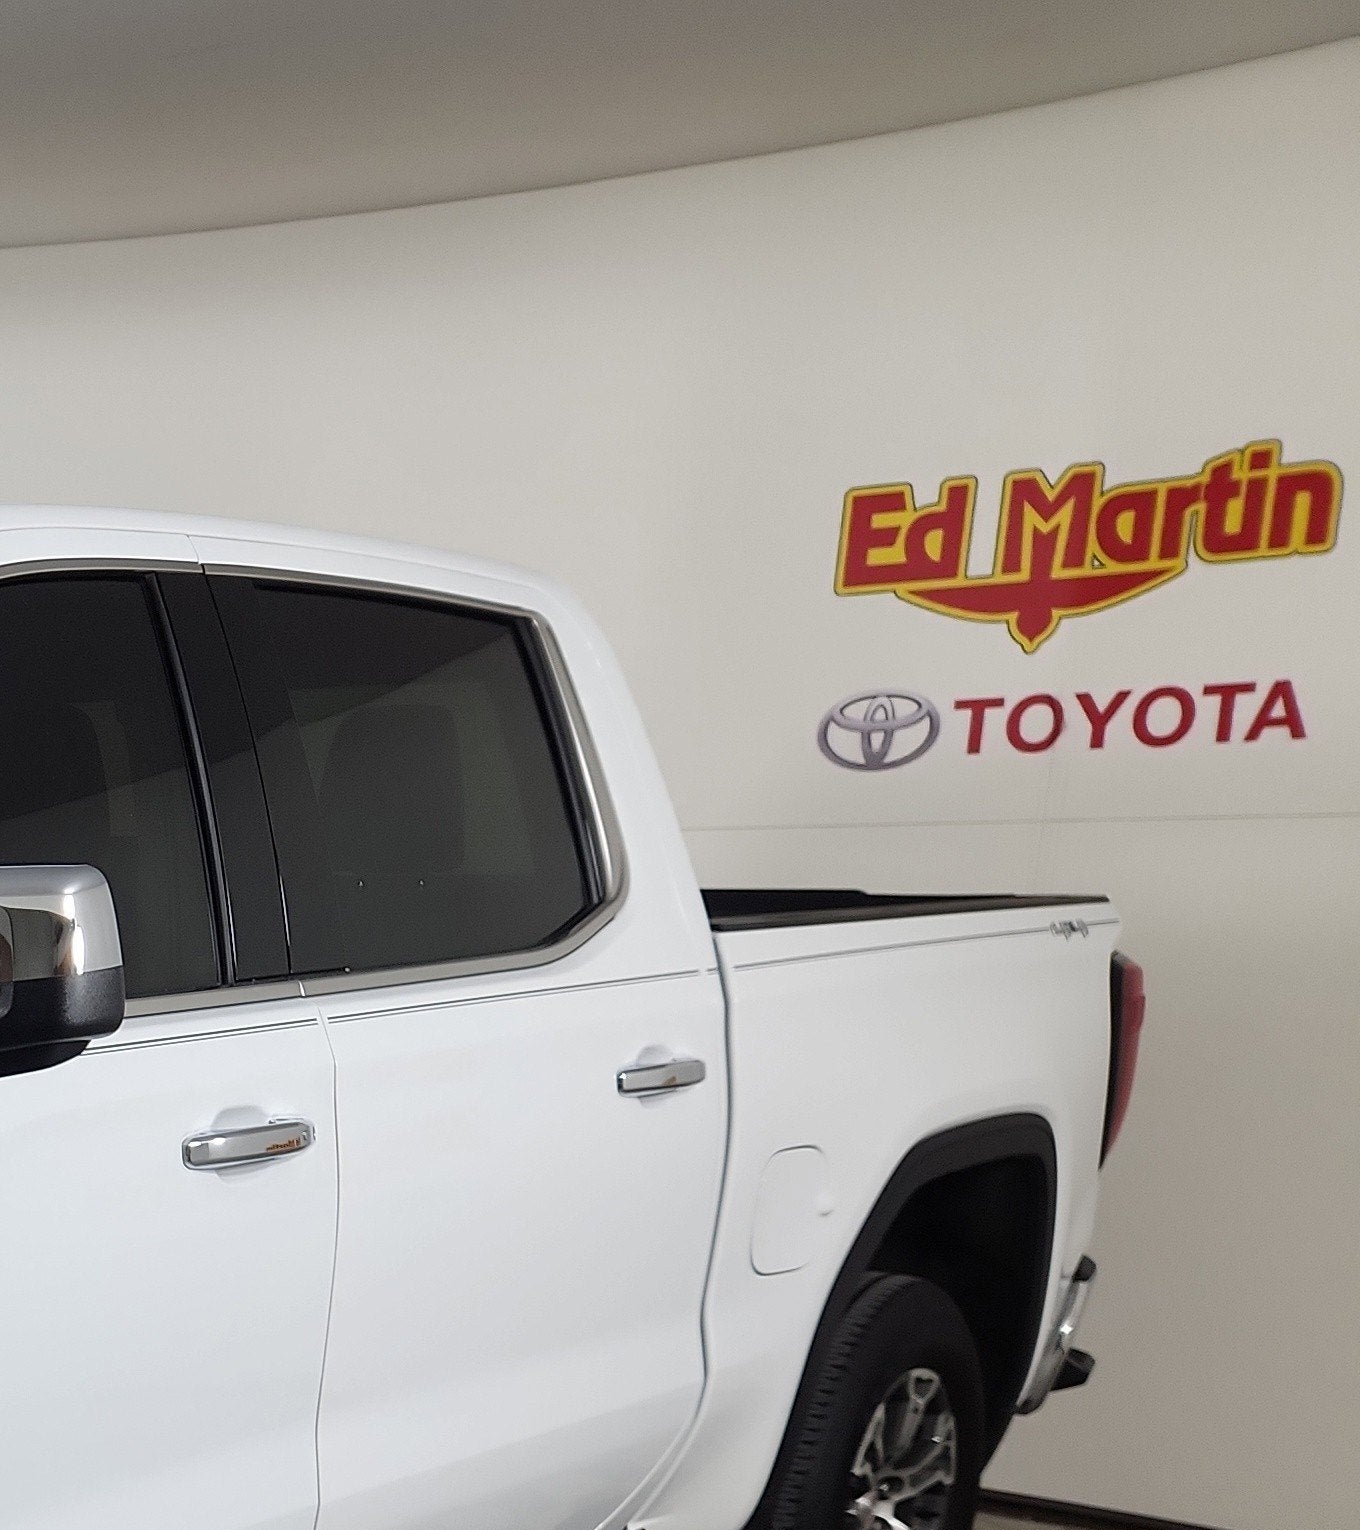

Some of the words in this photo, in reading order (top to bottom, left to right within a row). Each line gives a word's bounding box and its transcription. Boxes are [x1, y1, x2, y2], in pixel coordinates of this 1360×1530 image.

[836, 476, 976, 594] Ed
[995, 441, 1341, 582] Martin
[954, 679, 1307, 756] TOYOTA
